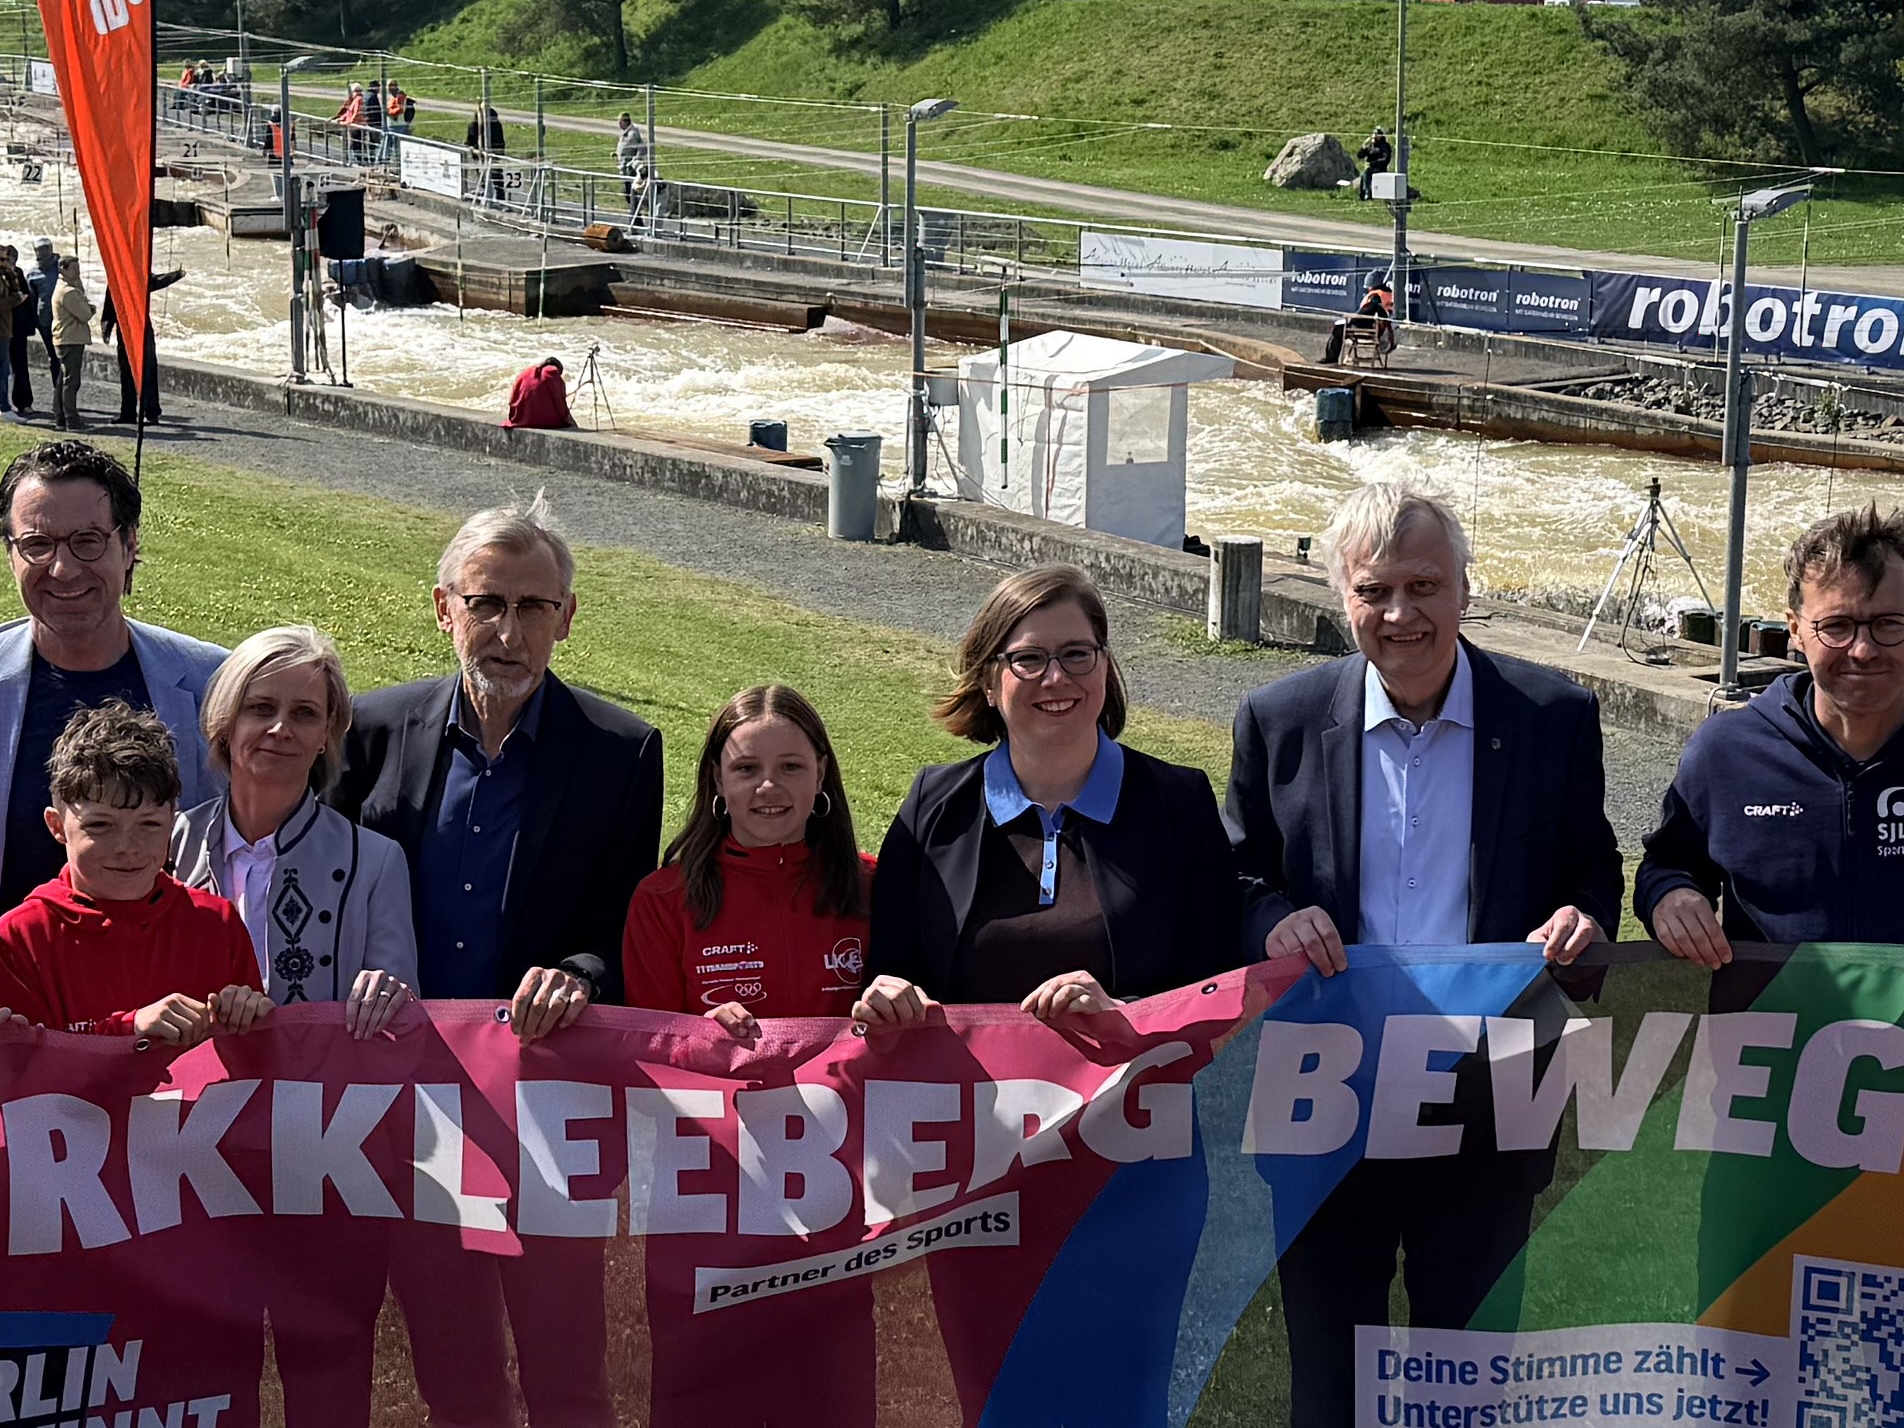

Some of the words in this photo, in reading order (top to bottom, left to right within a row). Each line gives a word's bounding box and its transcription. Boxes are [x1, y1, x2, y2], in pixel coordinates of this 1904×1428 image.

[23, 166, 42, 182] 22
[506, 172, 522, 189] 23
[1436, 286, 1496, 303] robotron
[1516, 292, 1578, 311] robotron
[1744, 804, 1790, 817] CRAFT
[702, 943, 746, 957] CRAFT
[708, 1260, 834, 1305] Partner
[843, 1238, 901, 1271] des
[908, 1203, 1012, 1254] Sports
[1377, 1348, 1478, 1386] Deine
[1490, 1347, 1623, 1385] Stimme
[1632, 1342, 1726, 1380] zählt
[1599, 1389, 1663, 1417] uns
[1673, 1386, 1770, 1428] jetzt!
